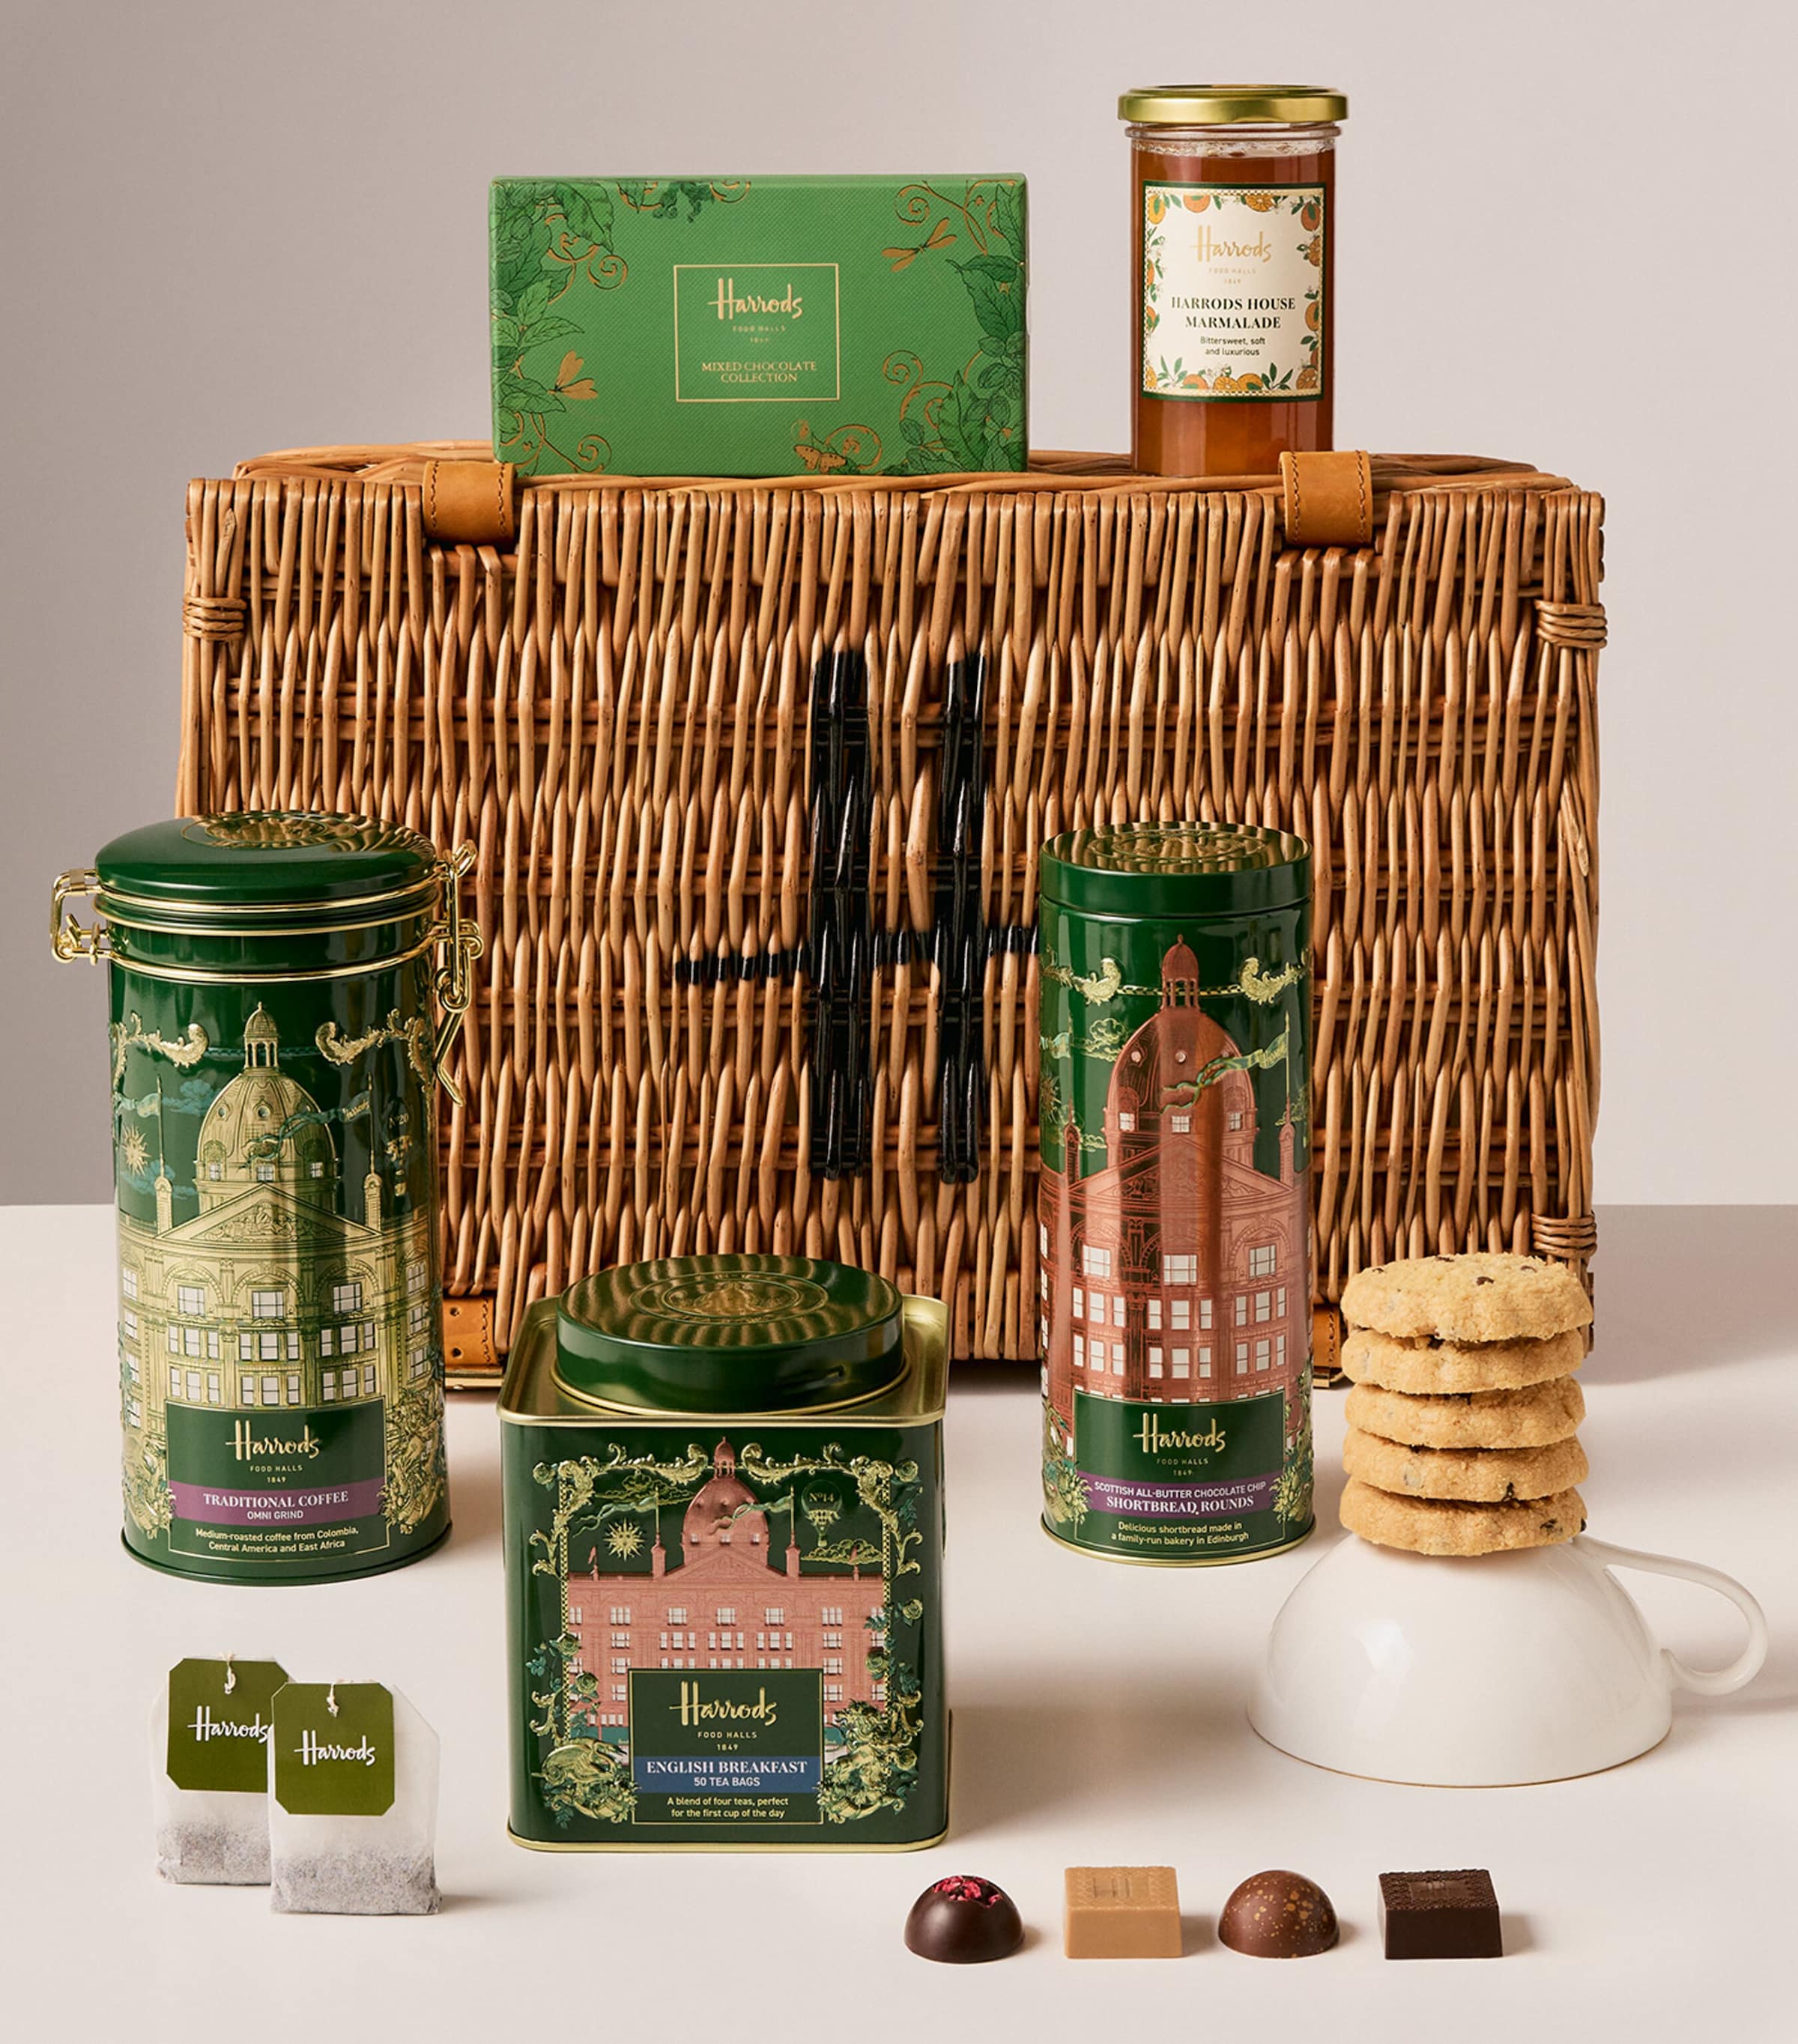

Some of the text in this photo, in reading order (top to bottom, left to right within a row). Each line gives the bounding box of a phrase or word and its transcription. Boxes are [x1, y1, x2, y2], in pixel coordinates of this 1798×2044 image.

[1189, 225, 1272, 263] Harrods
[707, 277, 803, 321] Harrods
[1171, 297, 1296, 310] HARRODS HOUSE
[1185, 316, 1282, 330] MARMALADE
[1200, 336, 1266, 346] Bittersweet, soft
[1205, 348, 1260, 356] and luxurious
[701, 360, 817, 372] MIXED CHOCOLATE
[720, 373, 798, 383] COLLECTION
[225, 1419, 320, 1461] Harrods
[1133, 1413, 1226, 1453] Harrods
[275, 1464, 303, 1473] HALLS
[1094, 1481, 1267, 1499] SCOTTISH ALL-BUTTER CHOCOLATE CHIP
[203, 1490, 349, 1508] TRADITIONAL COFFEE
[1201, 1496, 1255, 1514] ROUNDS
[247, 1510, 304, 1520] OMNI GRIND
[195, 1526, 360, 1542] Medium-roasted coffee from Colombia,
[1118, 1520, 1243, 1534] Delicious shortbread made in
[1119, 1533, 1163, 1546] family-run
[1163, 1535, 1195, 1546] bakery
[1196, 1535, 1205, 1544] in
[1206, 1530, 1250, 1545] Edinburgh
[208, 1538, 346, 1553] Central America and East Africa
[669, 1681, 778, 1726] Harrods
[187, 1705, 269, 1744] Harrods
[294, 1729, 376, 1766] Harrods
[716, 1743, 739, 1751] 1849
[647, 1761, 808, 1774] ENGLISH BREAKFAST
[694, 1777, 761, 1787] 50 TEA BAGS
[667, 1797, 789, 1808] A blend of four teas, perfect
[671, 1809, 786, 1820] for the first cup of the day
